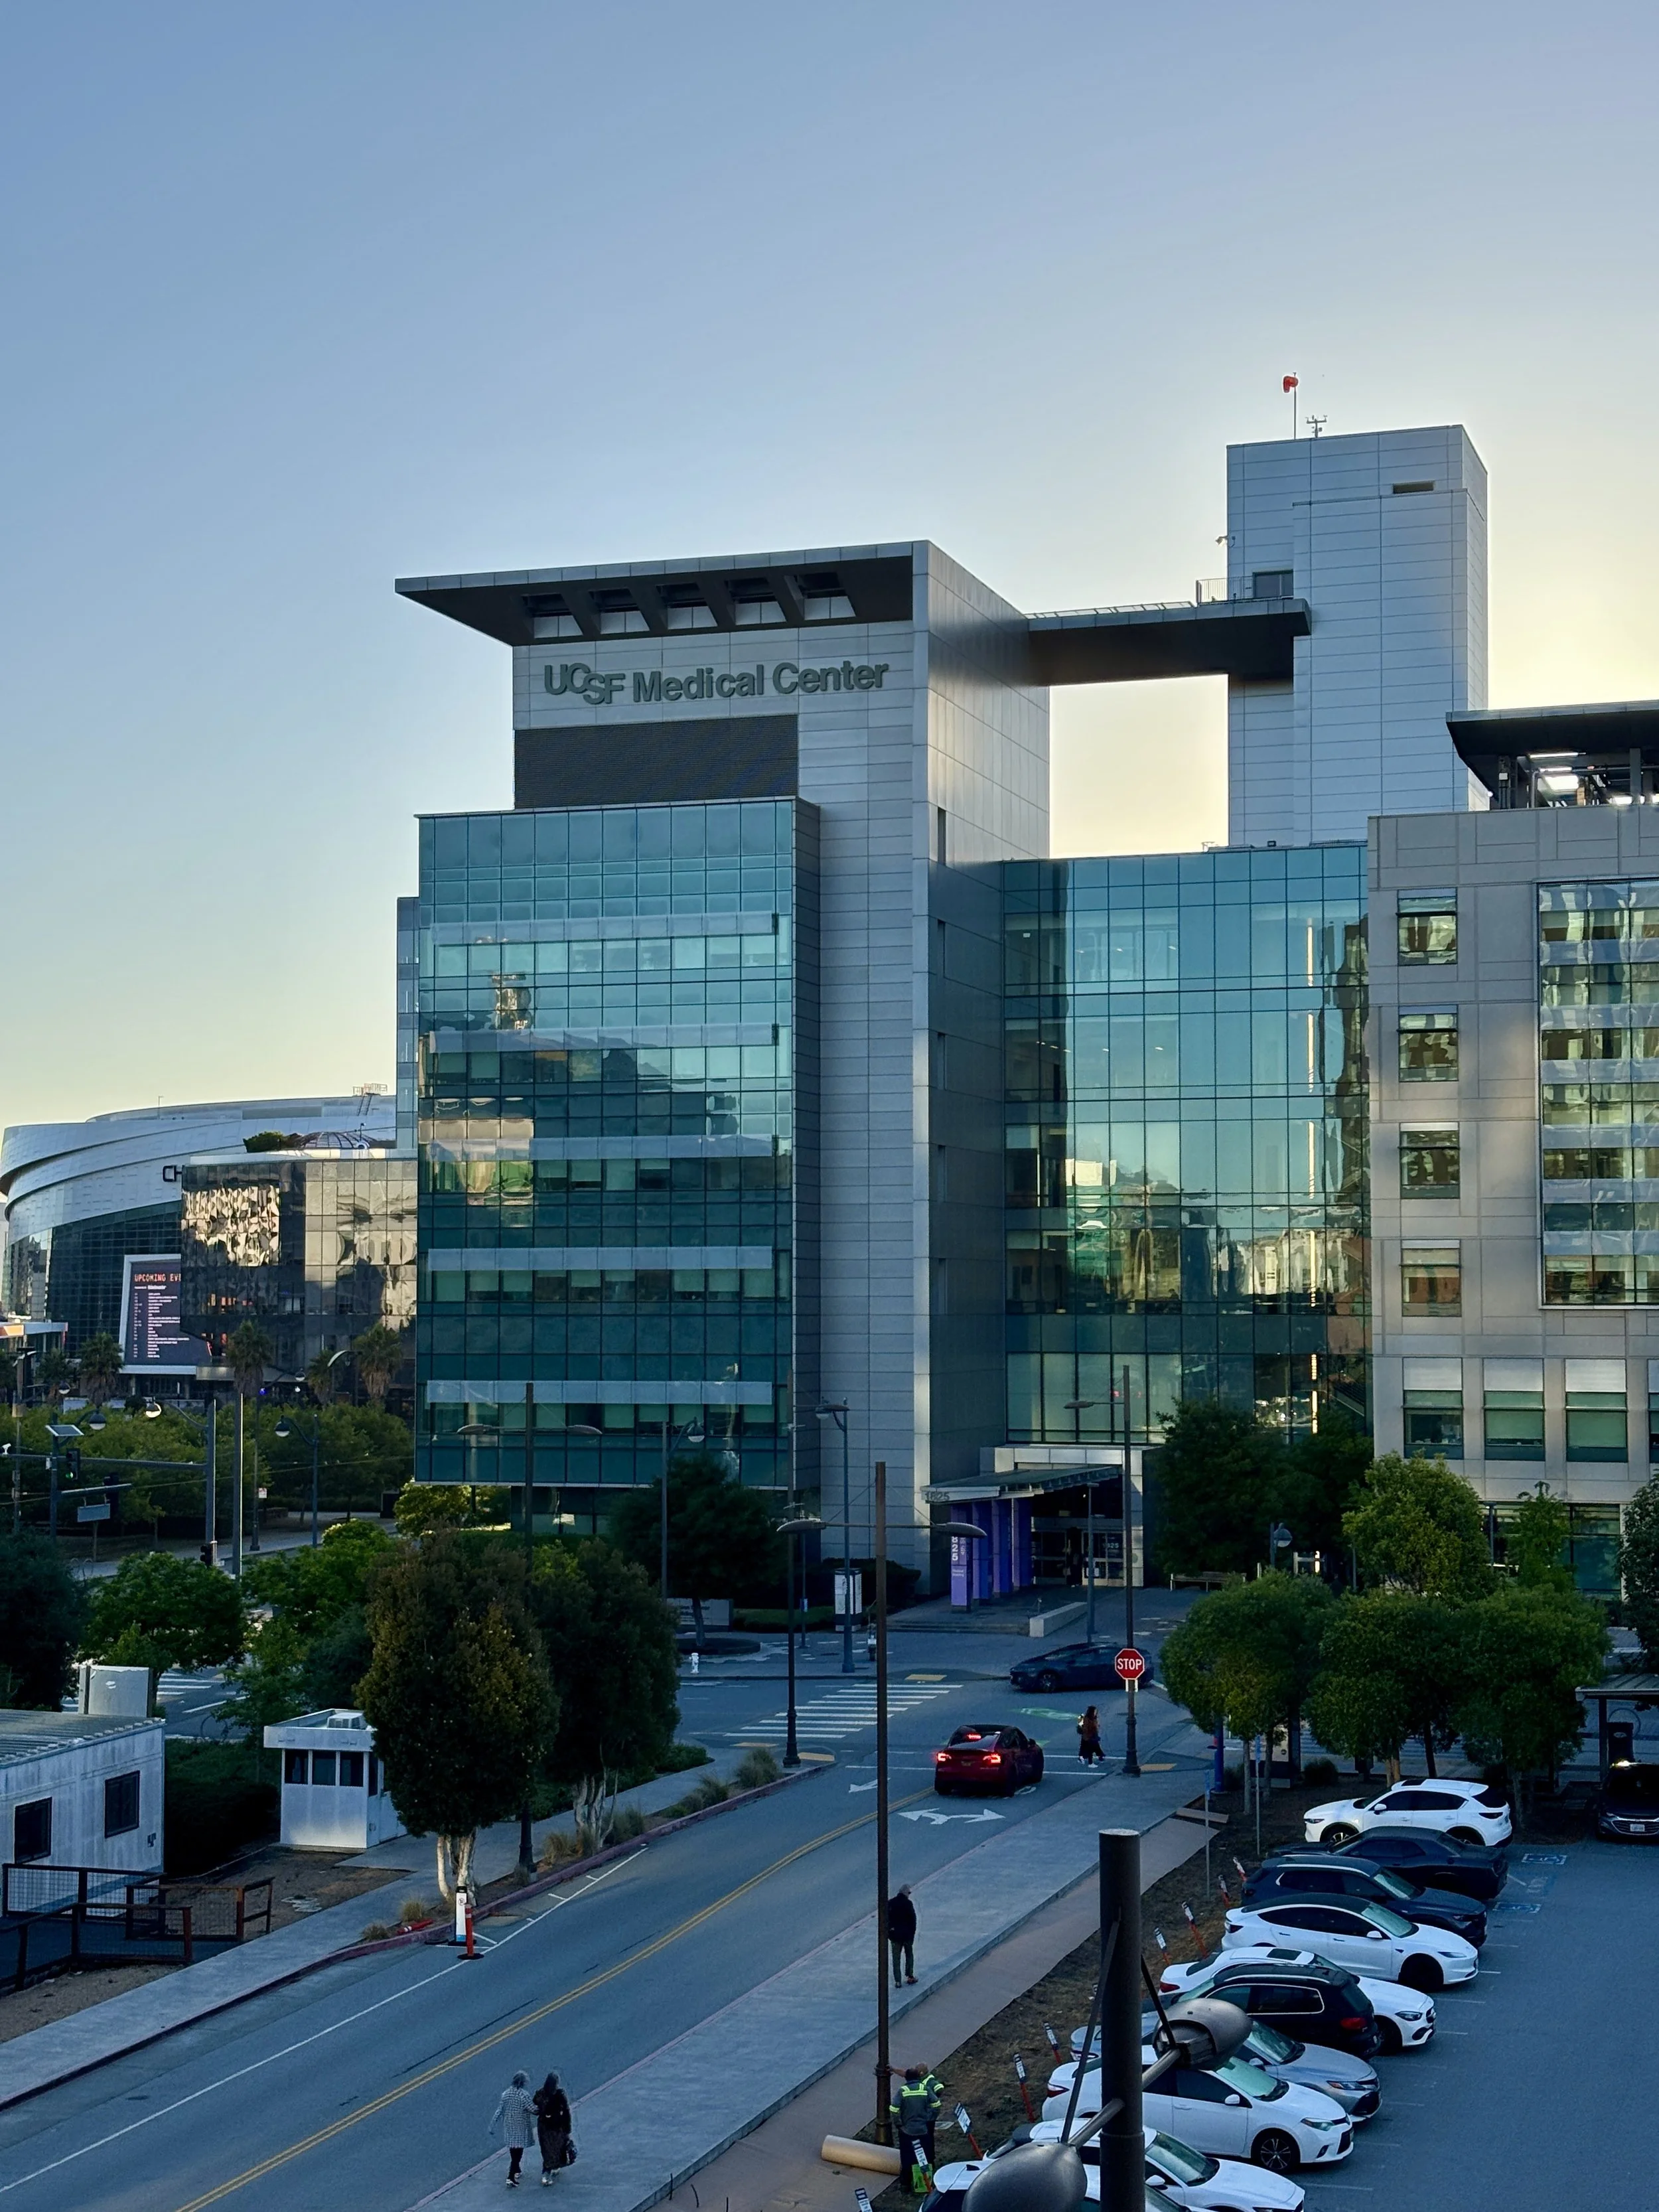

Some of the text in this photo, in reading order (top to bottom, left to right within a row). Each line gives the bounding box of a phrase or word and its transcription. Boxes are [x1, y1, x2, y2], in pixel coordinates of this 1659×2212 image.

[543, 660, 889, 705] UCSF Medical Center
[1117, 1659, 1142, 1670] STOP
